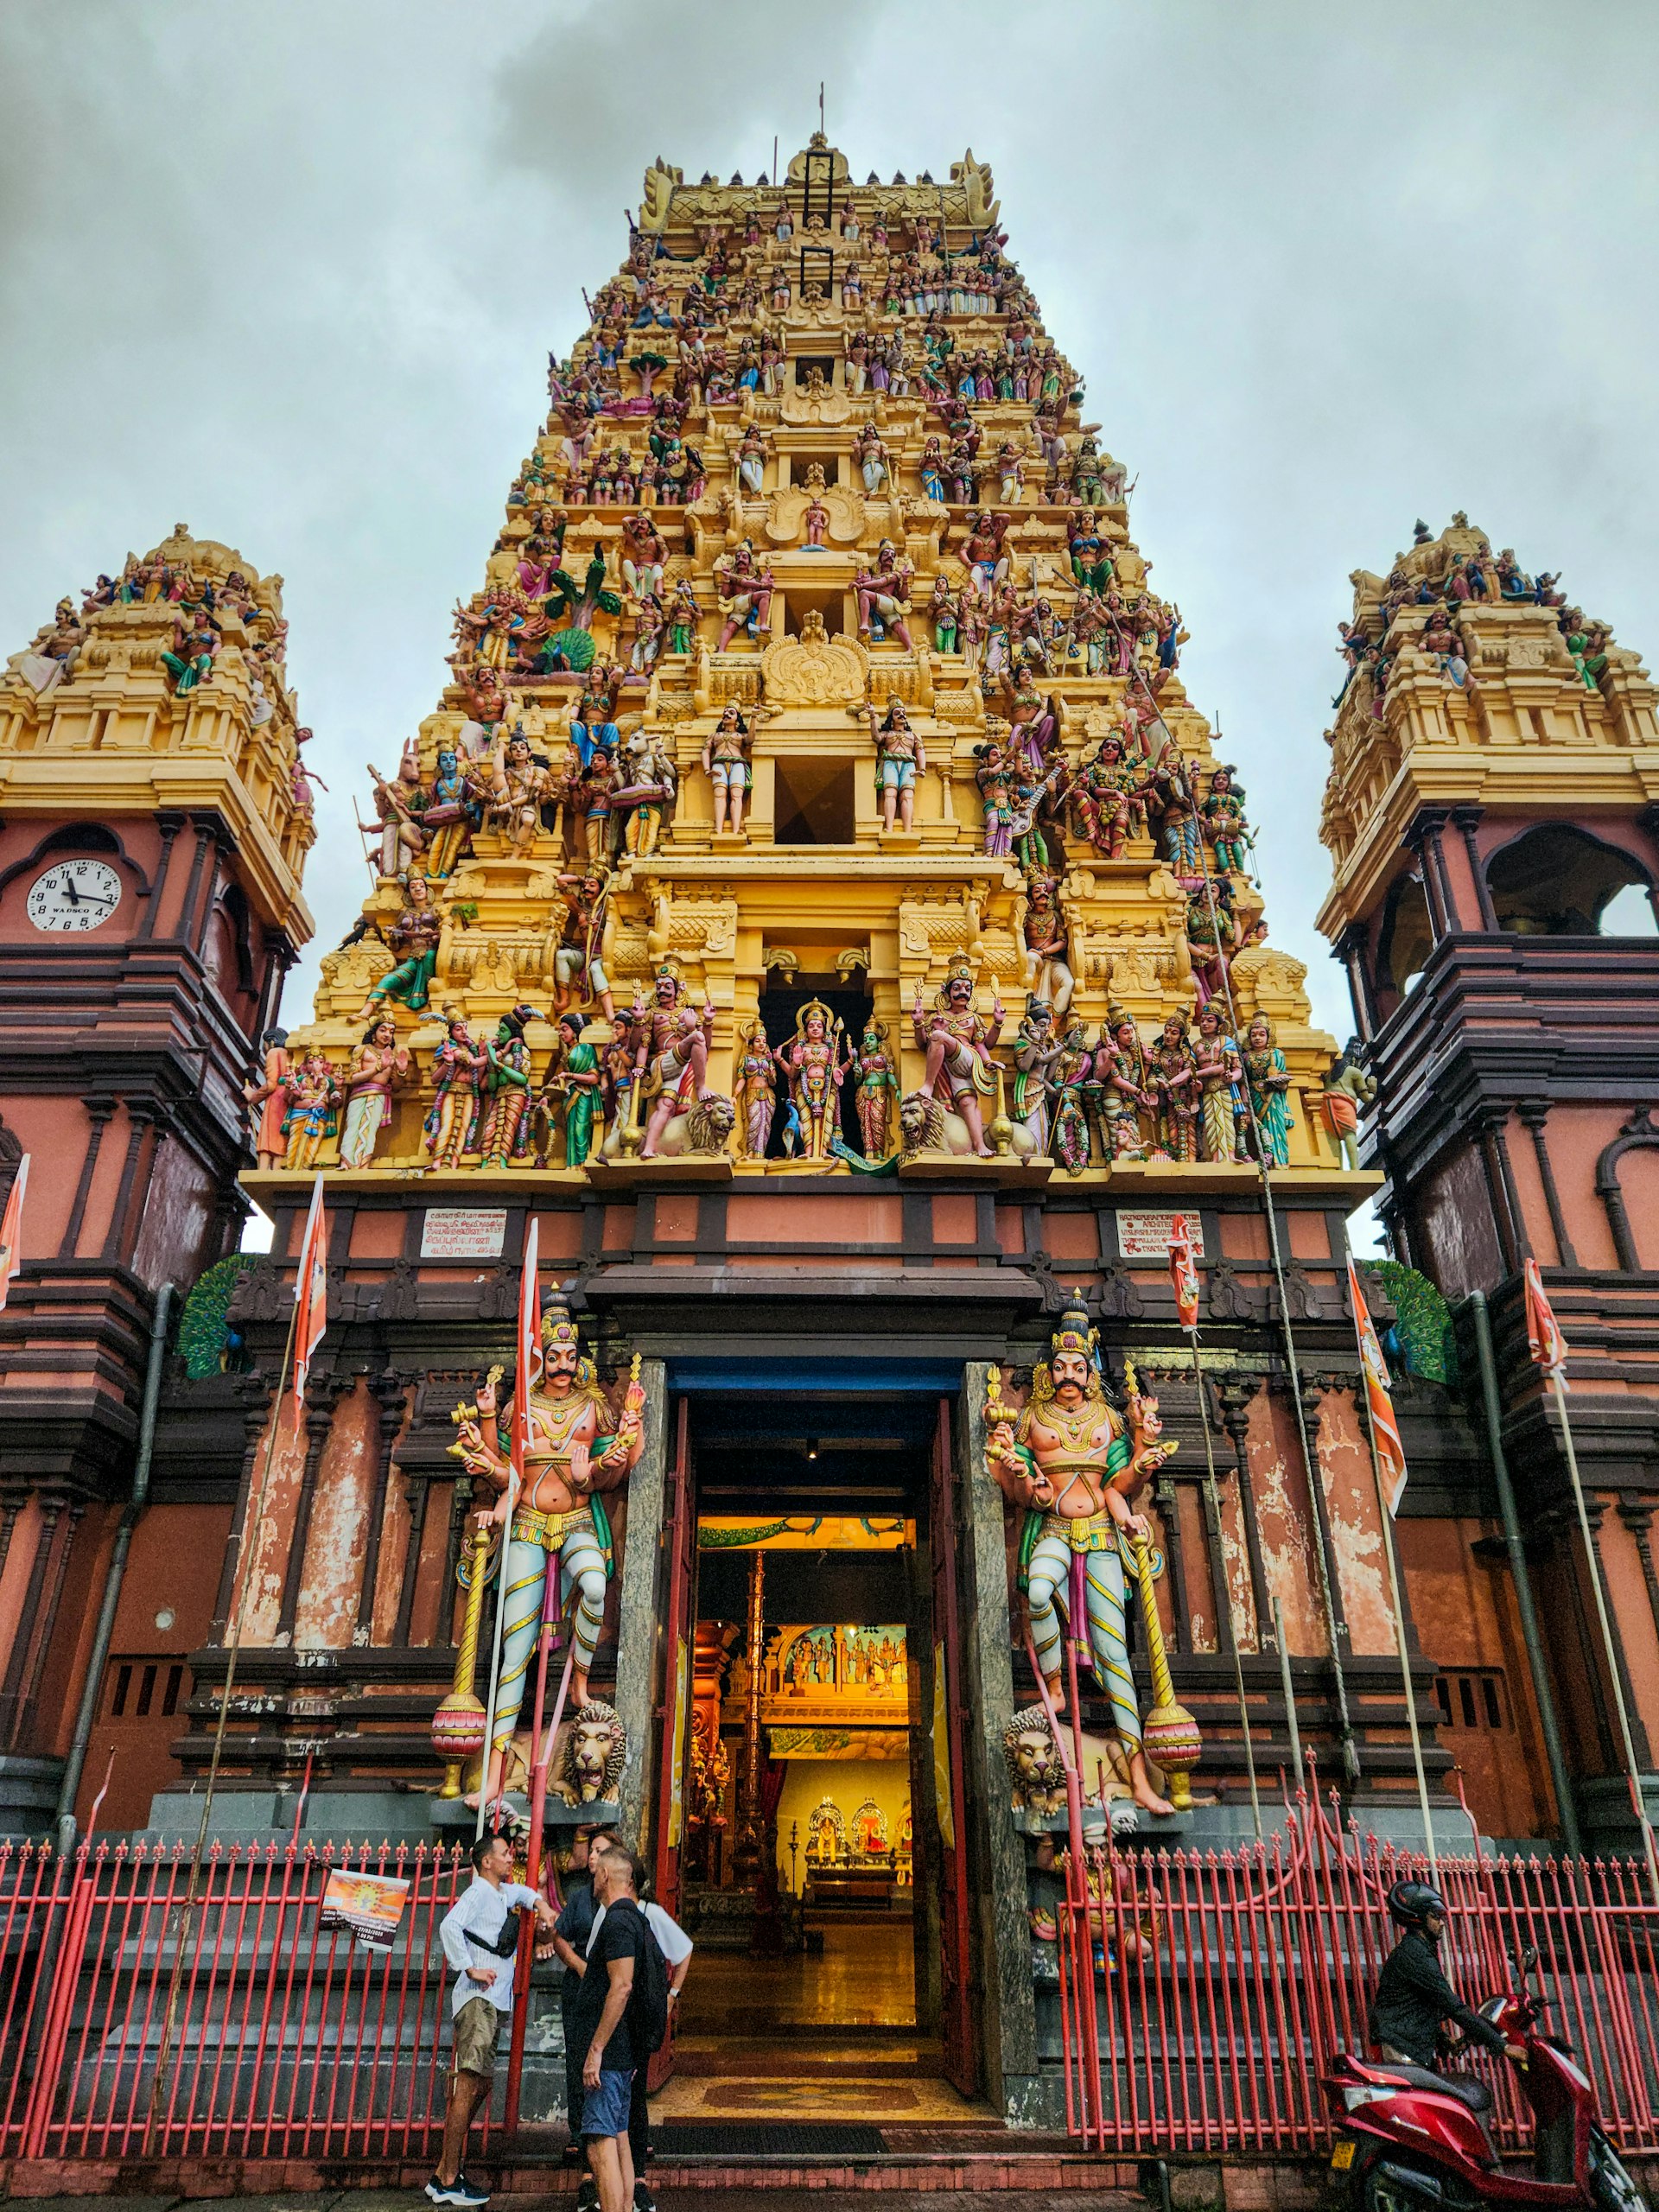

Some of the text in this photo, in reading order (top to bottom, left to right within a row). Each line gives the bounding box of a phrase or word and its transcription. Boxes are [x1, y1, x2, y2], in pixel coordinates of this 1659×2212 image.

[61, 870, 70, 879] 11
[76, 867, 87, 875] 12
[97, 871, 101, 880] 1
[46, 880, 57, 889] 10
[104, 881, 111, 890] 2
[36, 893, 44, 901] 9
[106, 894, 113, 903] 3
[38, 906, 46, 914] 8
[95, 907, 103, 916] 4
[48, 917, 56, 925] 7
[63, 921, 72, 930] 6
[80, 917, 88, 926] 5
